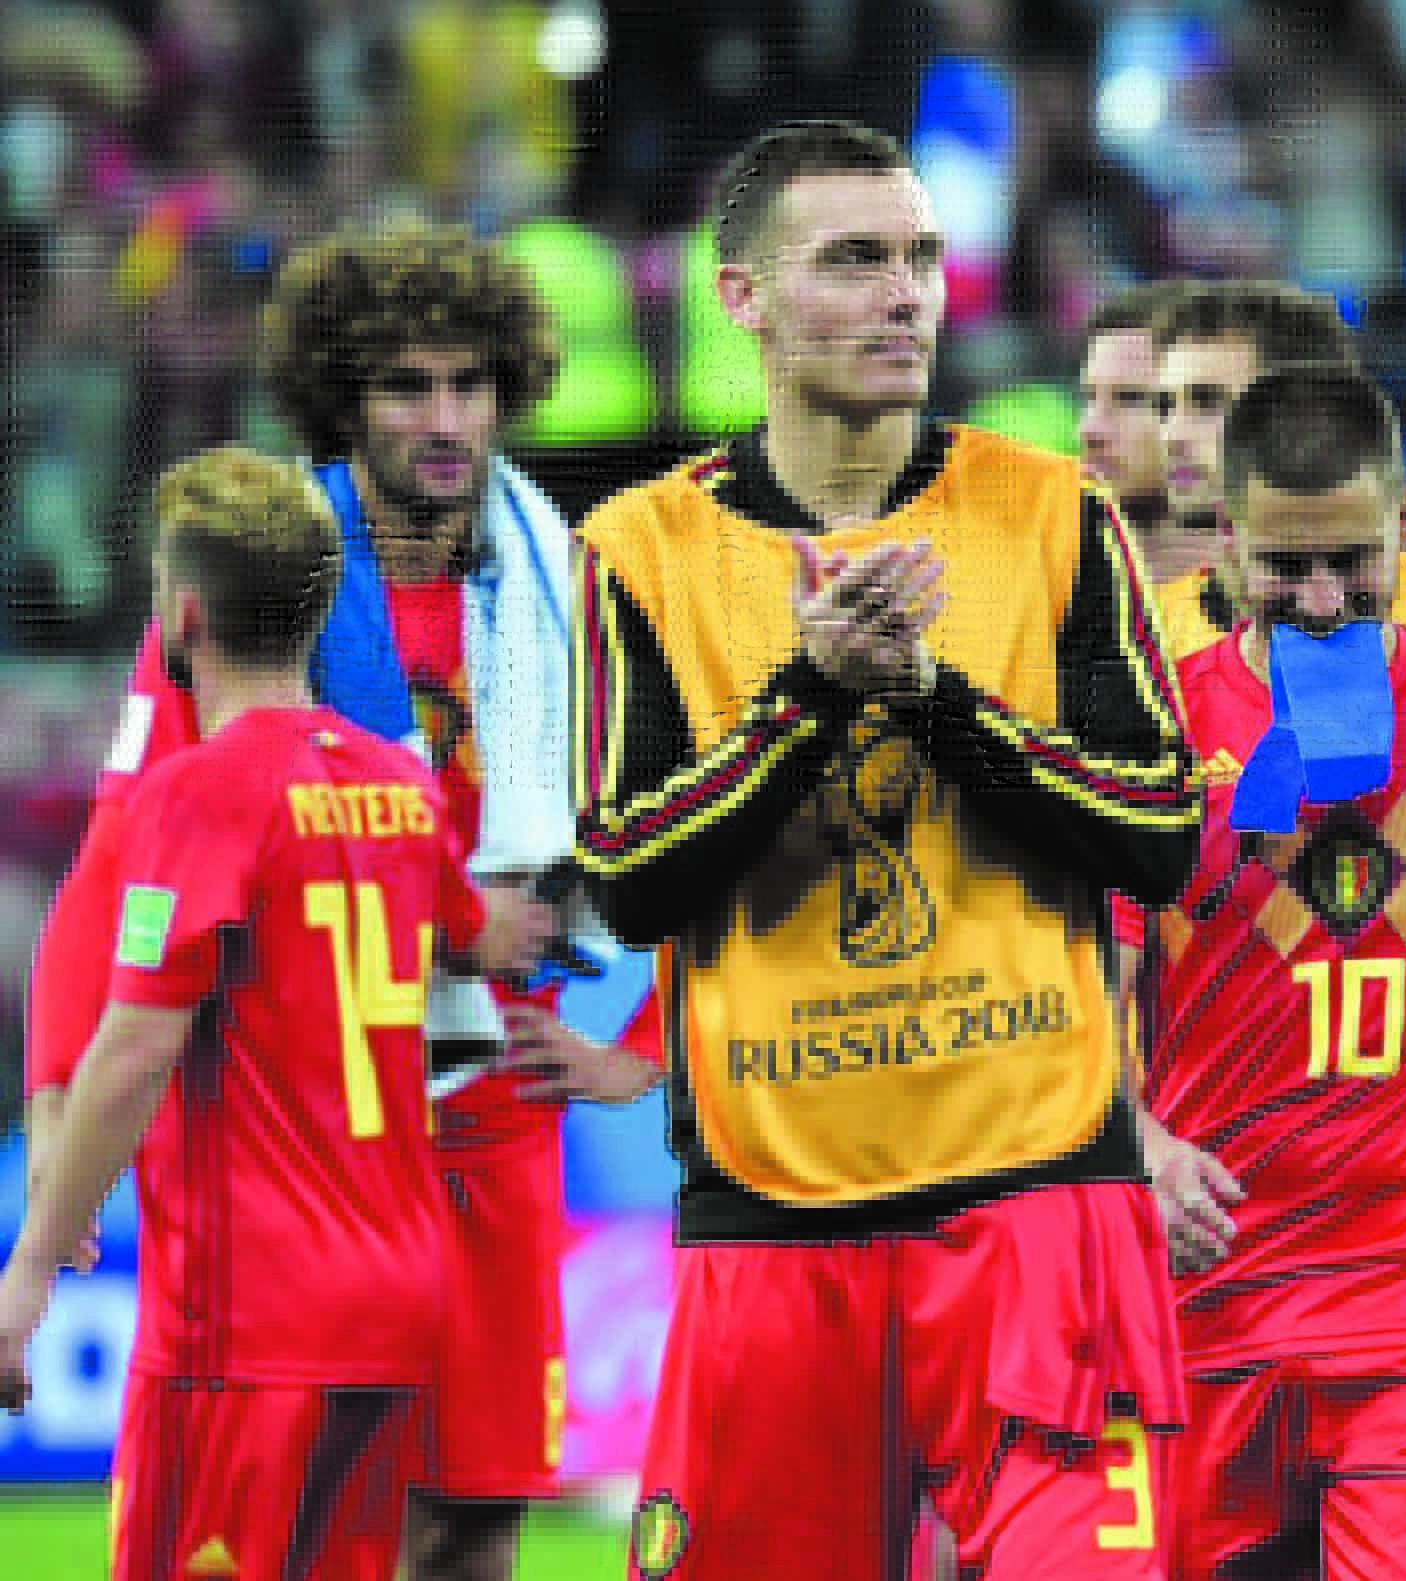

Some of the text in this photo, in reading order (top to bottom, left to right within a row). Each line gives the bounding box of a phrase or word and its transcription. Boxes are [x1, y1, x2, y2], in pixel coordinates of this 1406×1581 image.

[303, 881, 434, 1140] 14
[727, 983, 1072, 1088] RUSSIA 2018
[1097, 1419, 1155, 1548] 3
